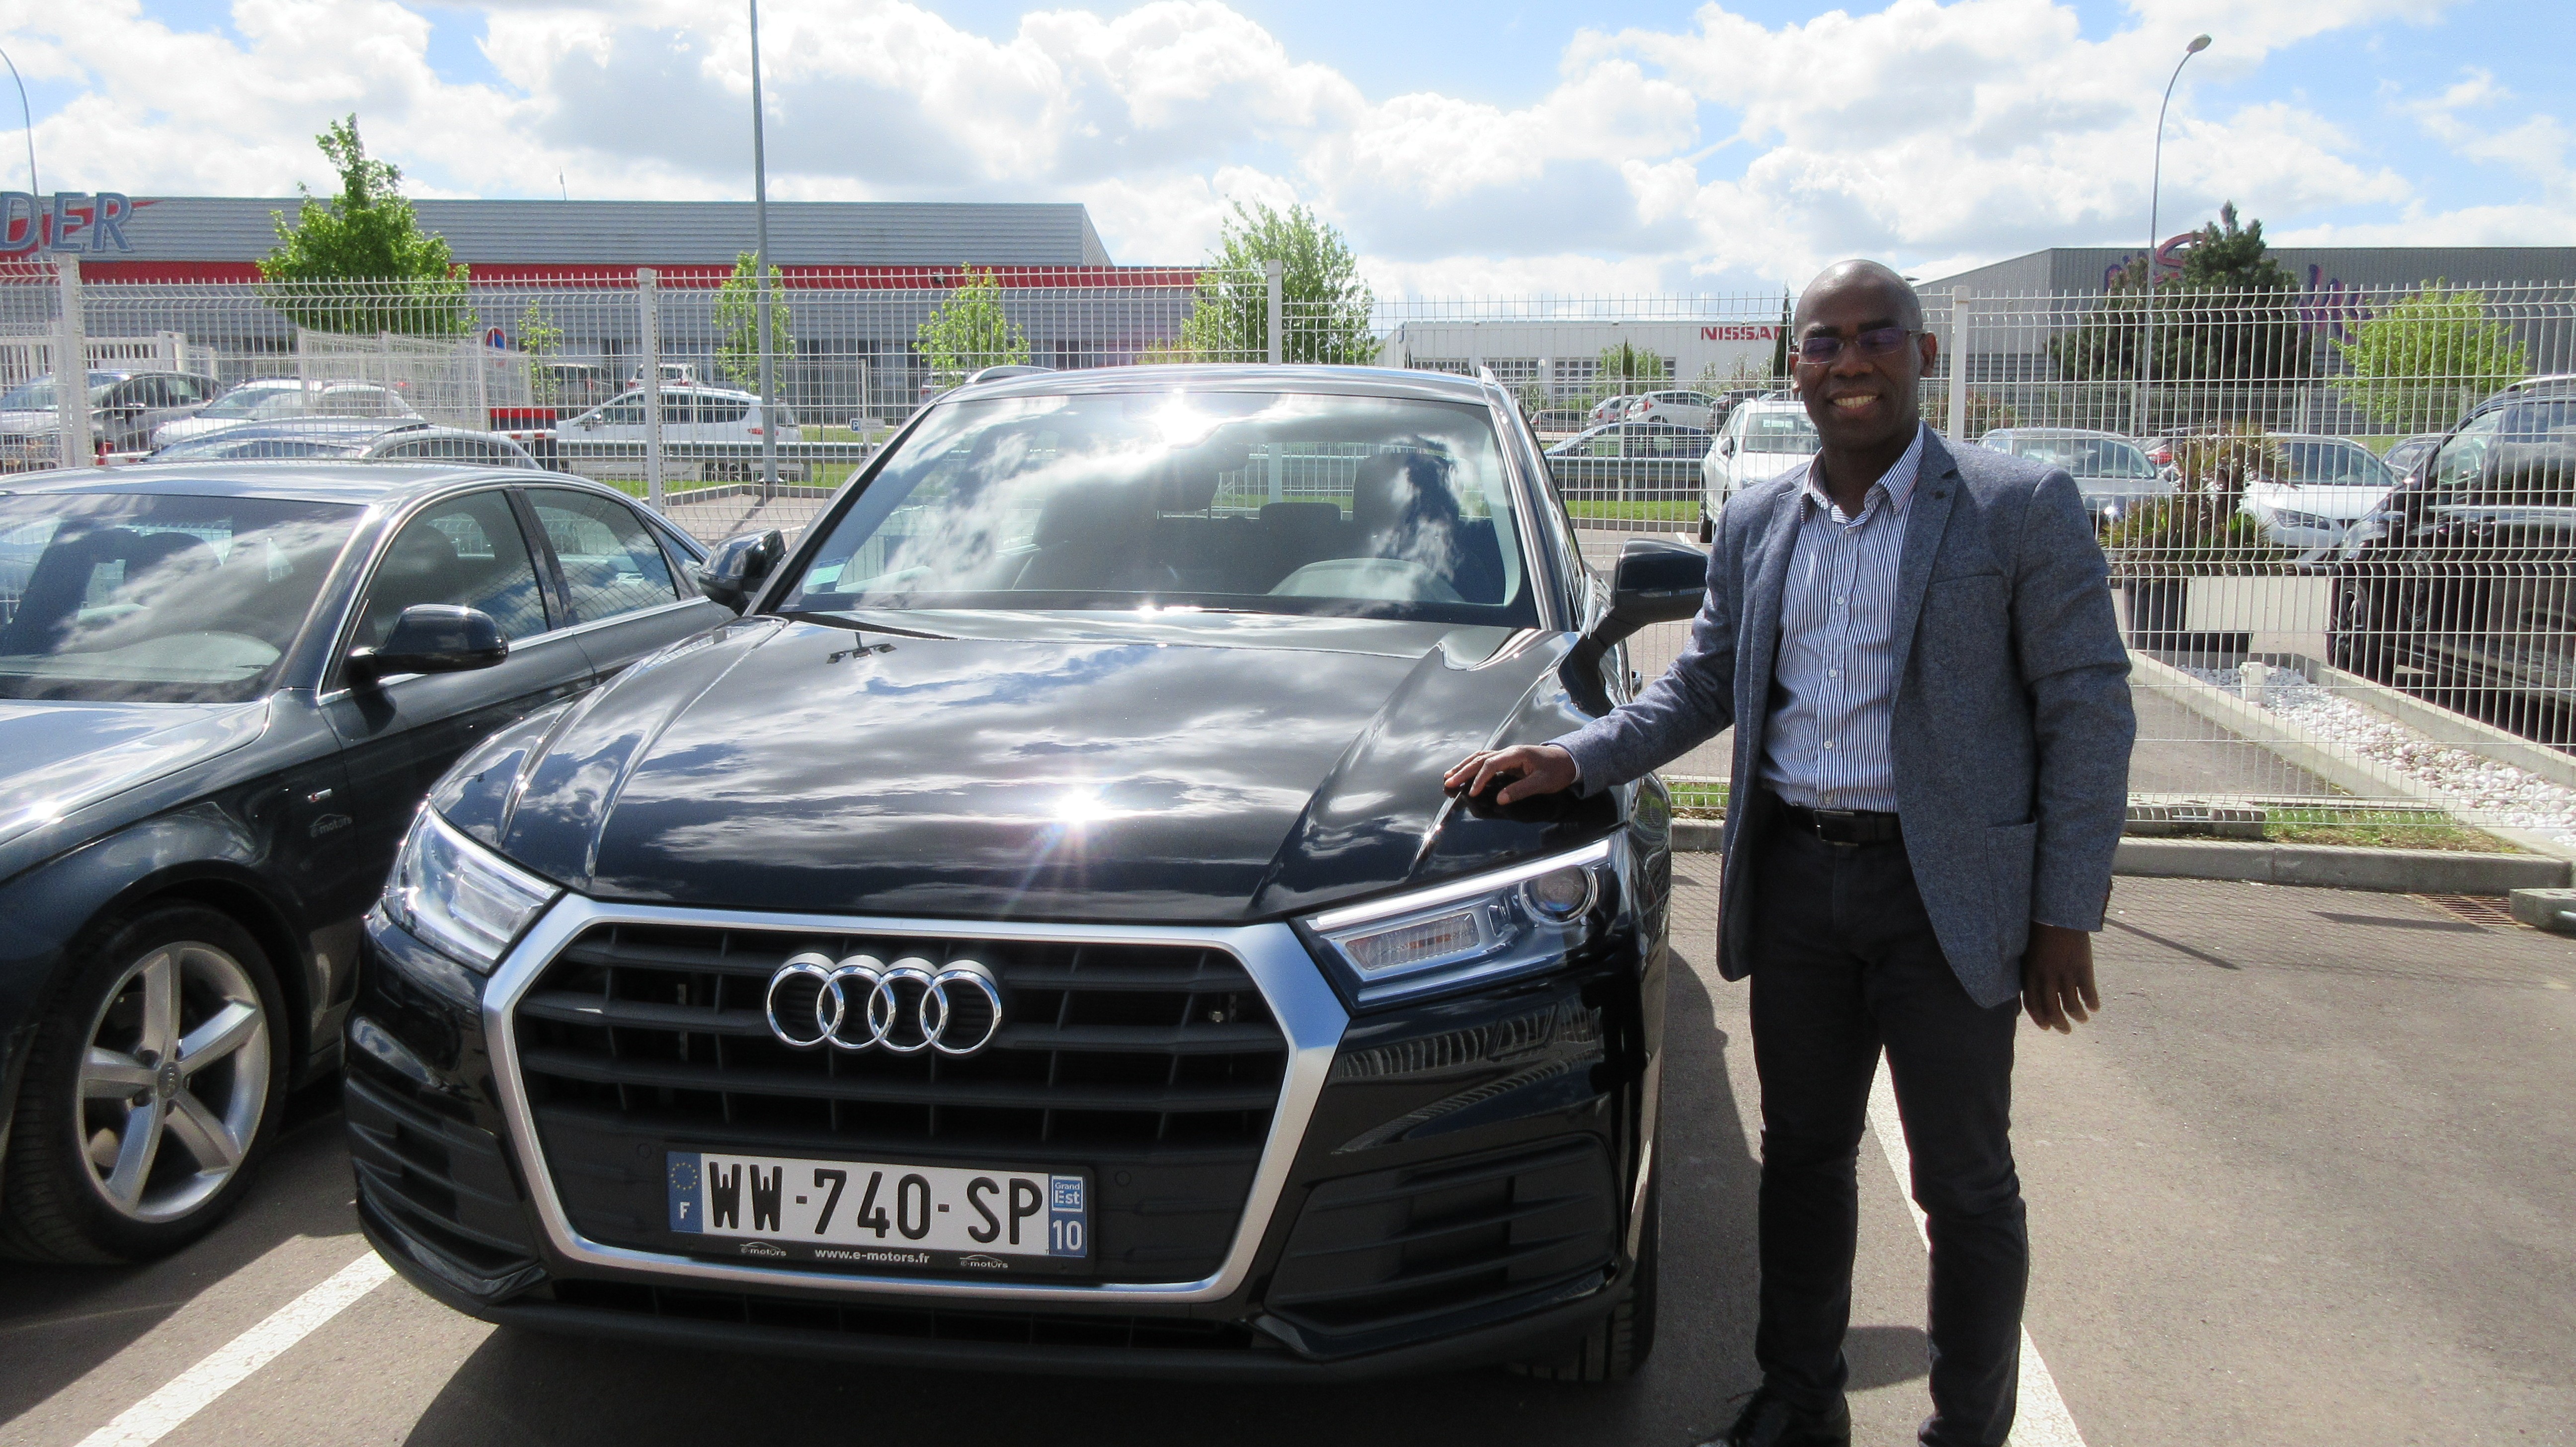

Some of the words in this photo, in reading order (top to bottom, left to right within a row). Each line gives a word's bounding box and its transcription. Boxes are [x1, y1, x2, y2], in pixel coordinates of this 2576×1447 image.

[1054, 1182, 1080, 1191] Grand
[1054, 1190, 1080, 1205] Est
[679, 1201, 691, 1219] F
[1053, 1219, 1082, 1250] 10
[814, 1249, 930, 1264] www.e-motors.fr
